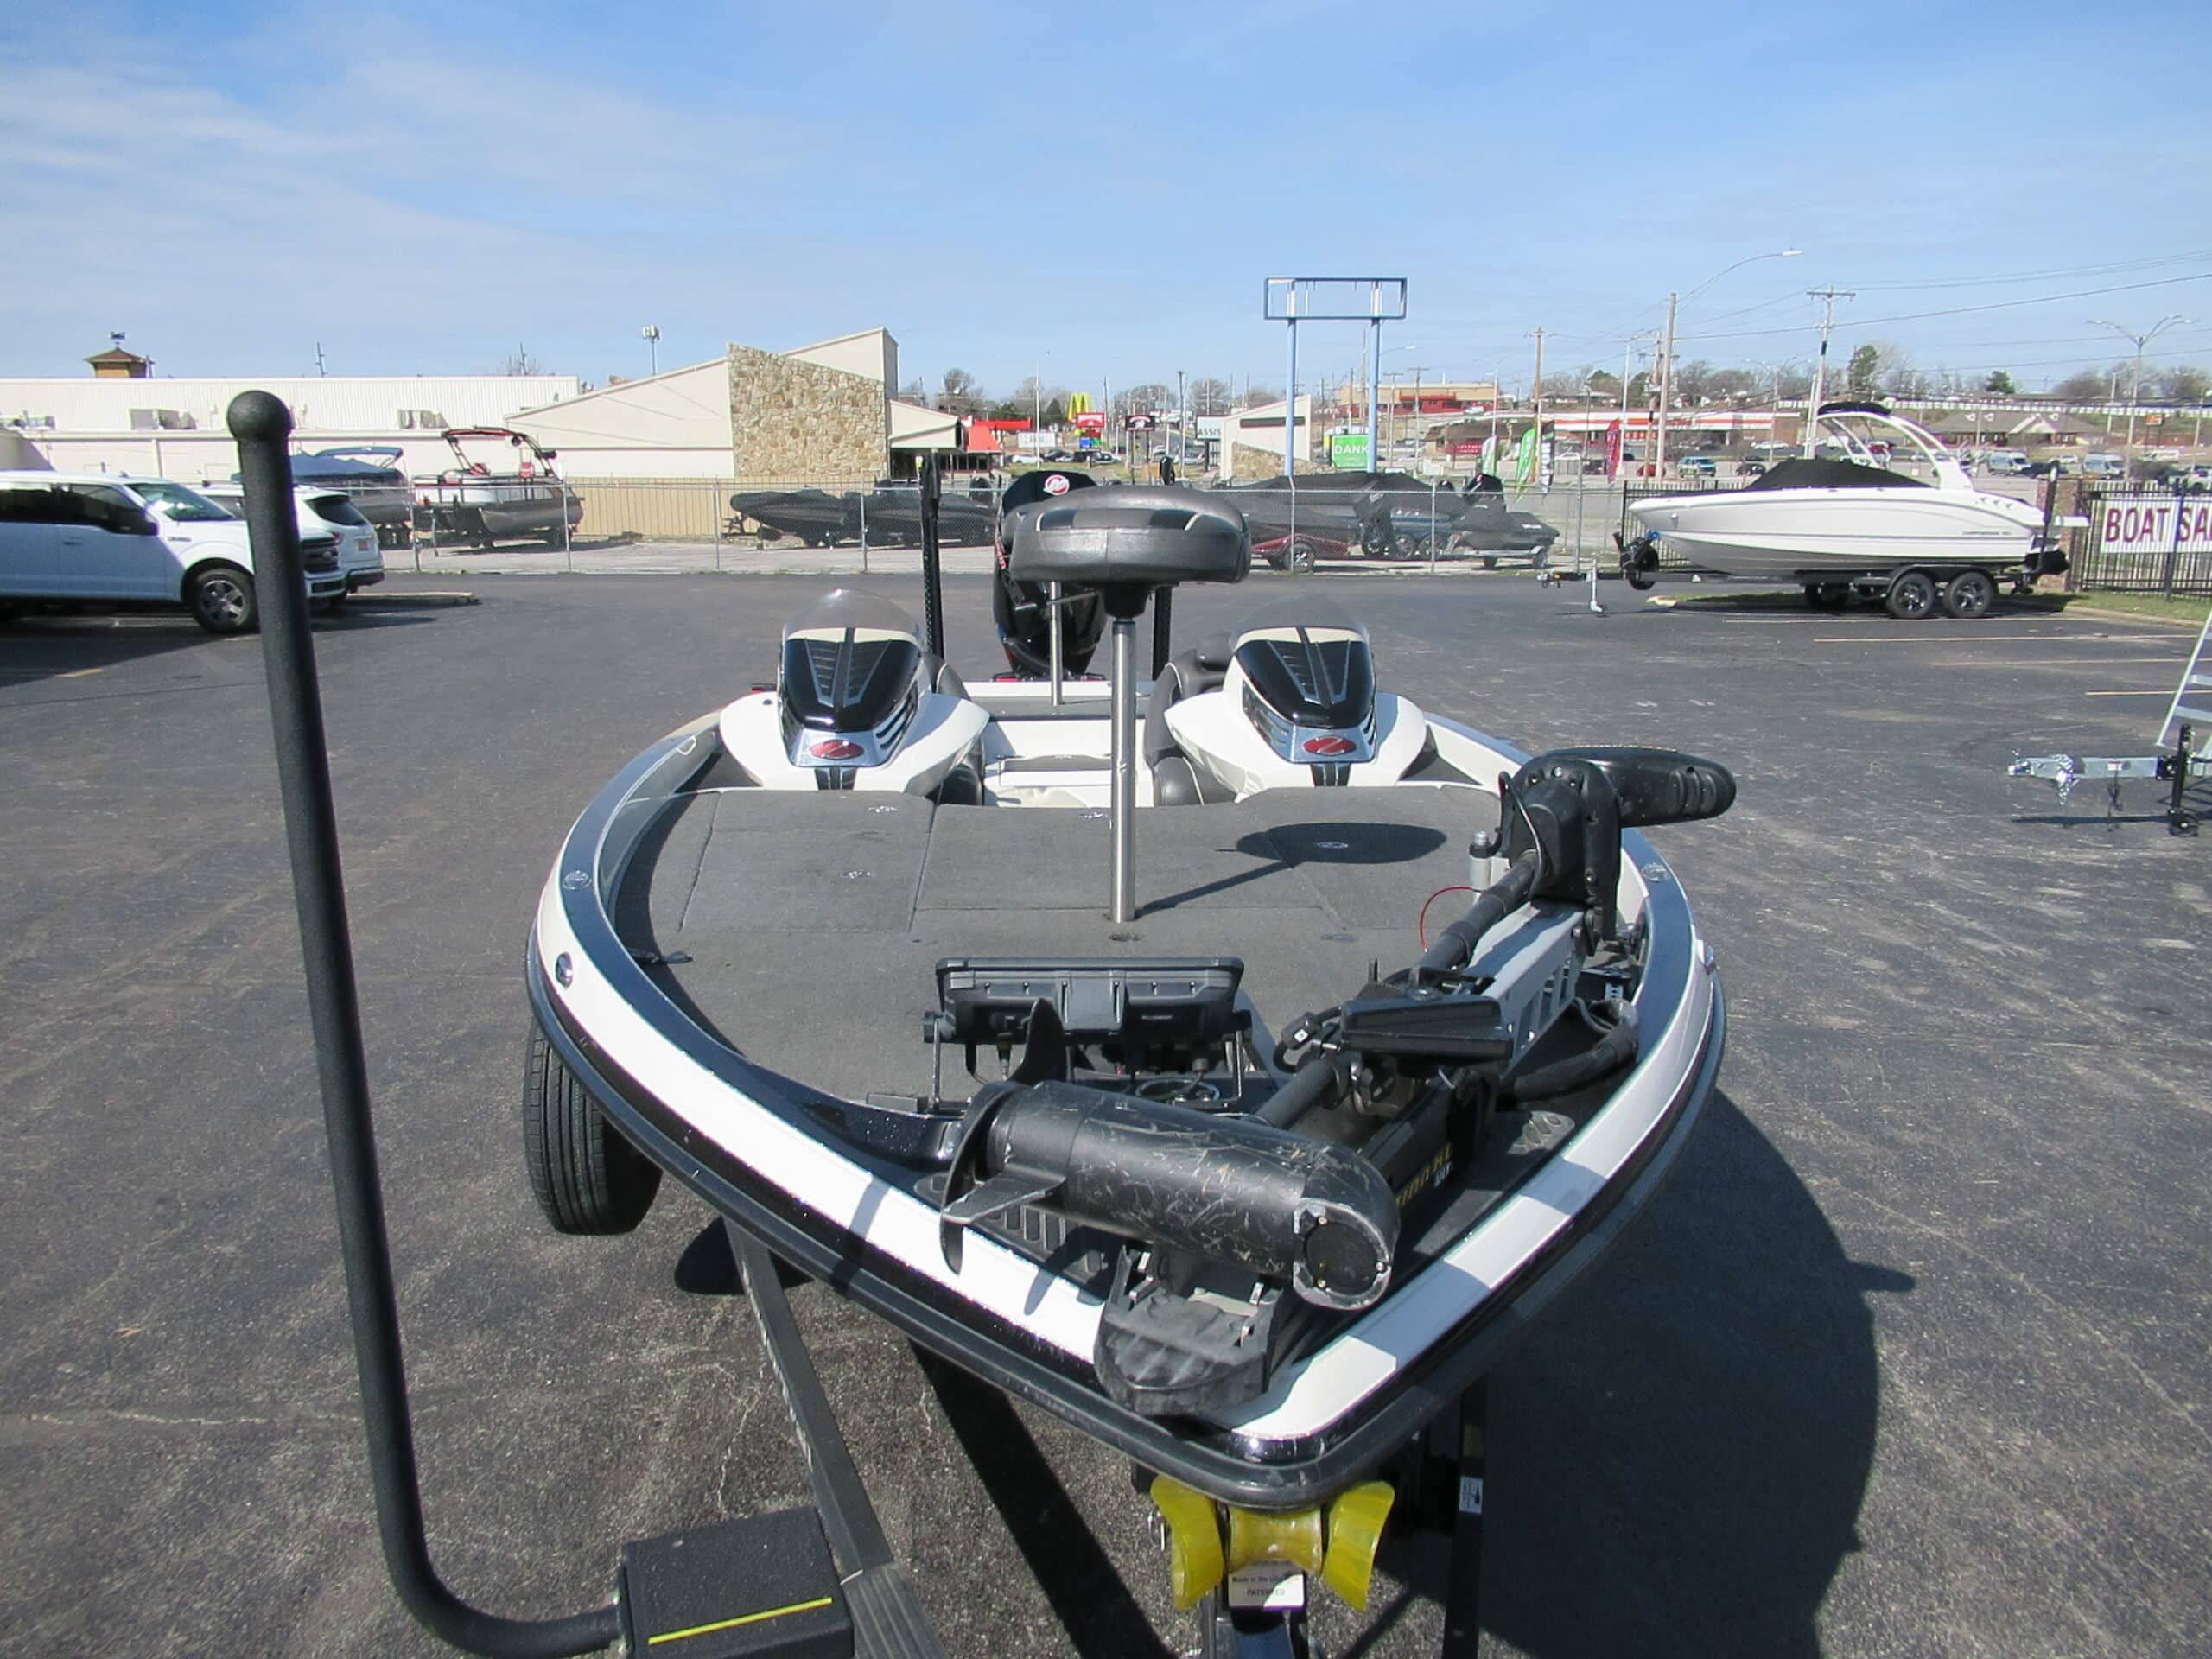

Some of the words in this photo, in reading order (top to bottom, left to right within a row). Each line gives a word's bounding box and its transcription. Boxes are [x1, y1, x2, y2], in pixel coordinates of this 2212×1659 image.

[1334, 445, 1370, 455] DANK
[2105, 507, 2171, 543] BOAT
[2177, 507, 2212, 543] SA
